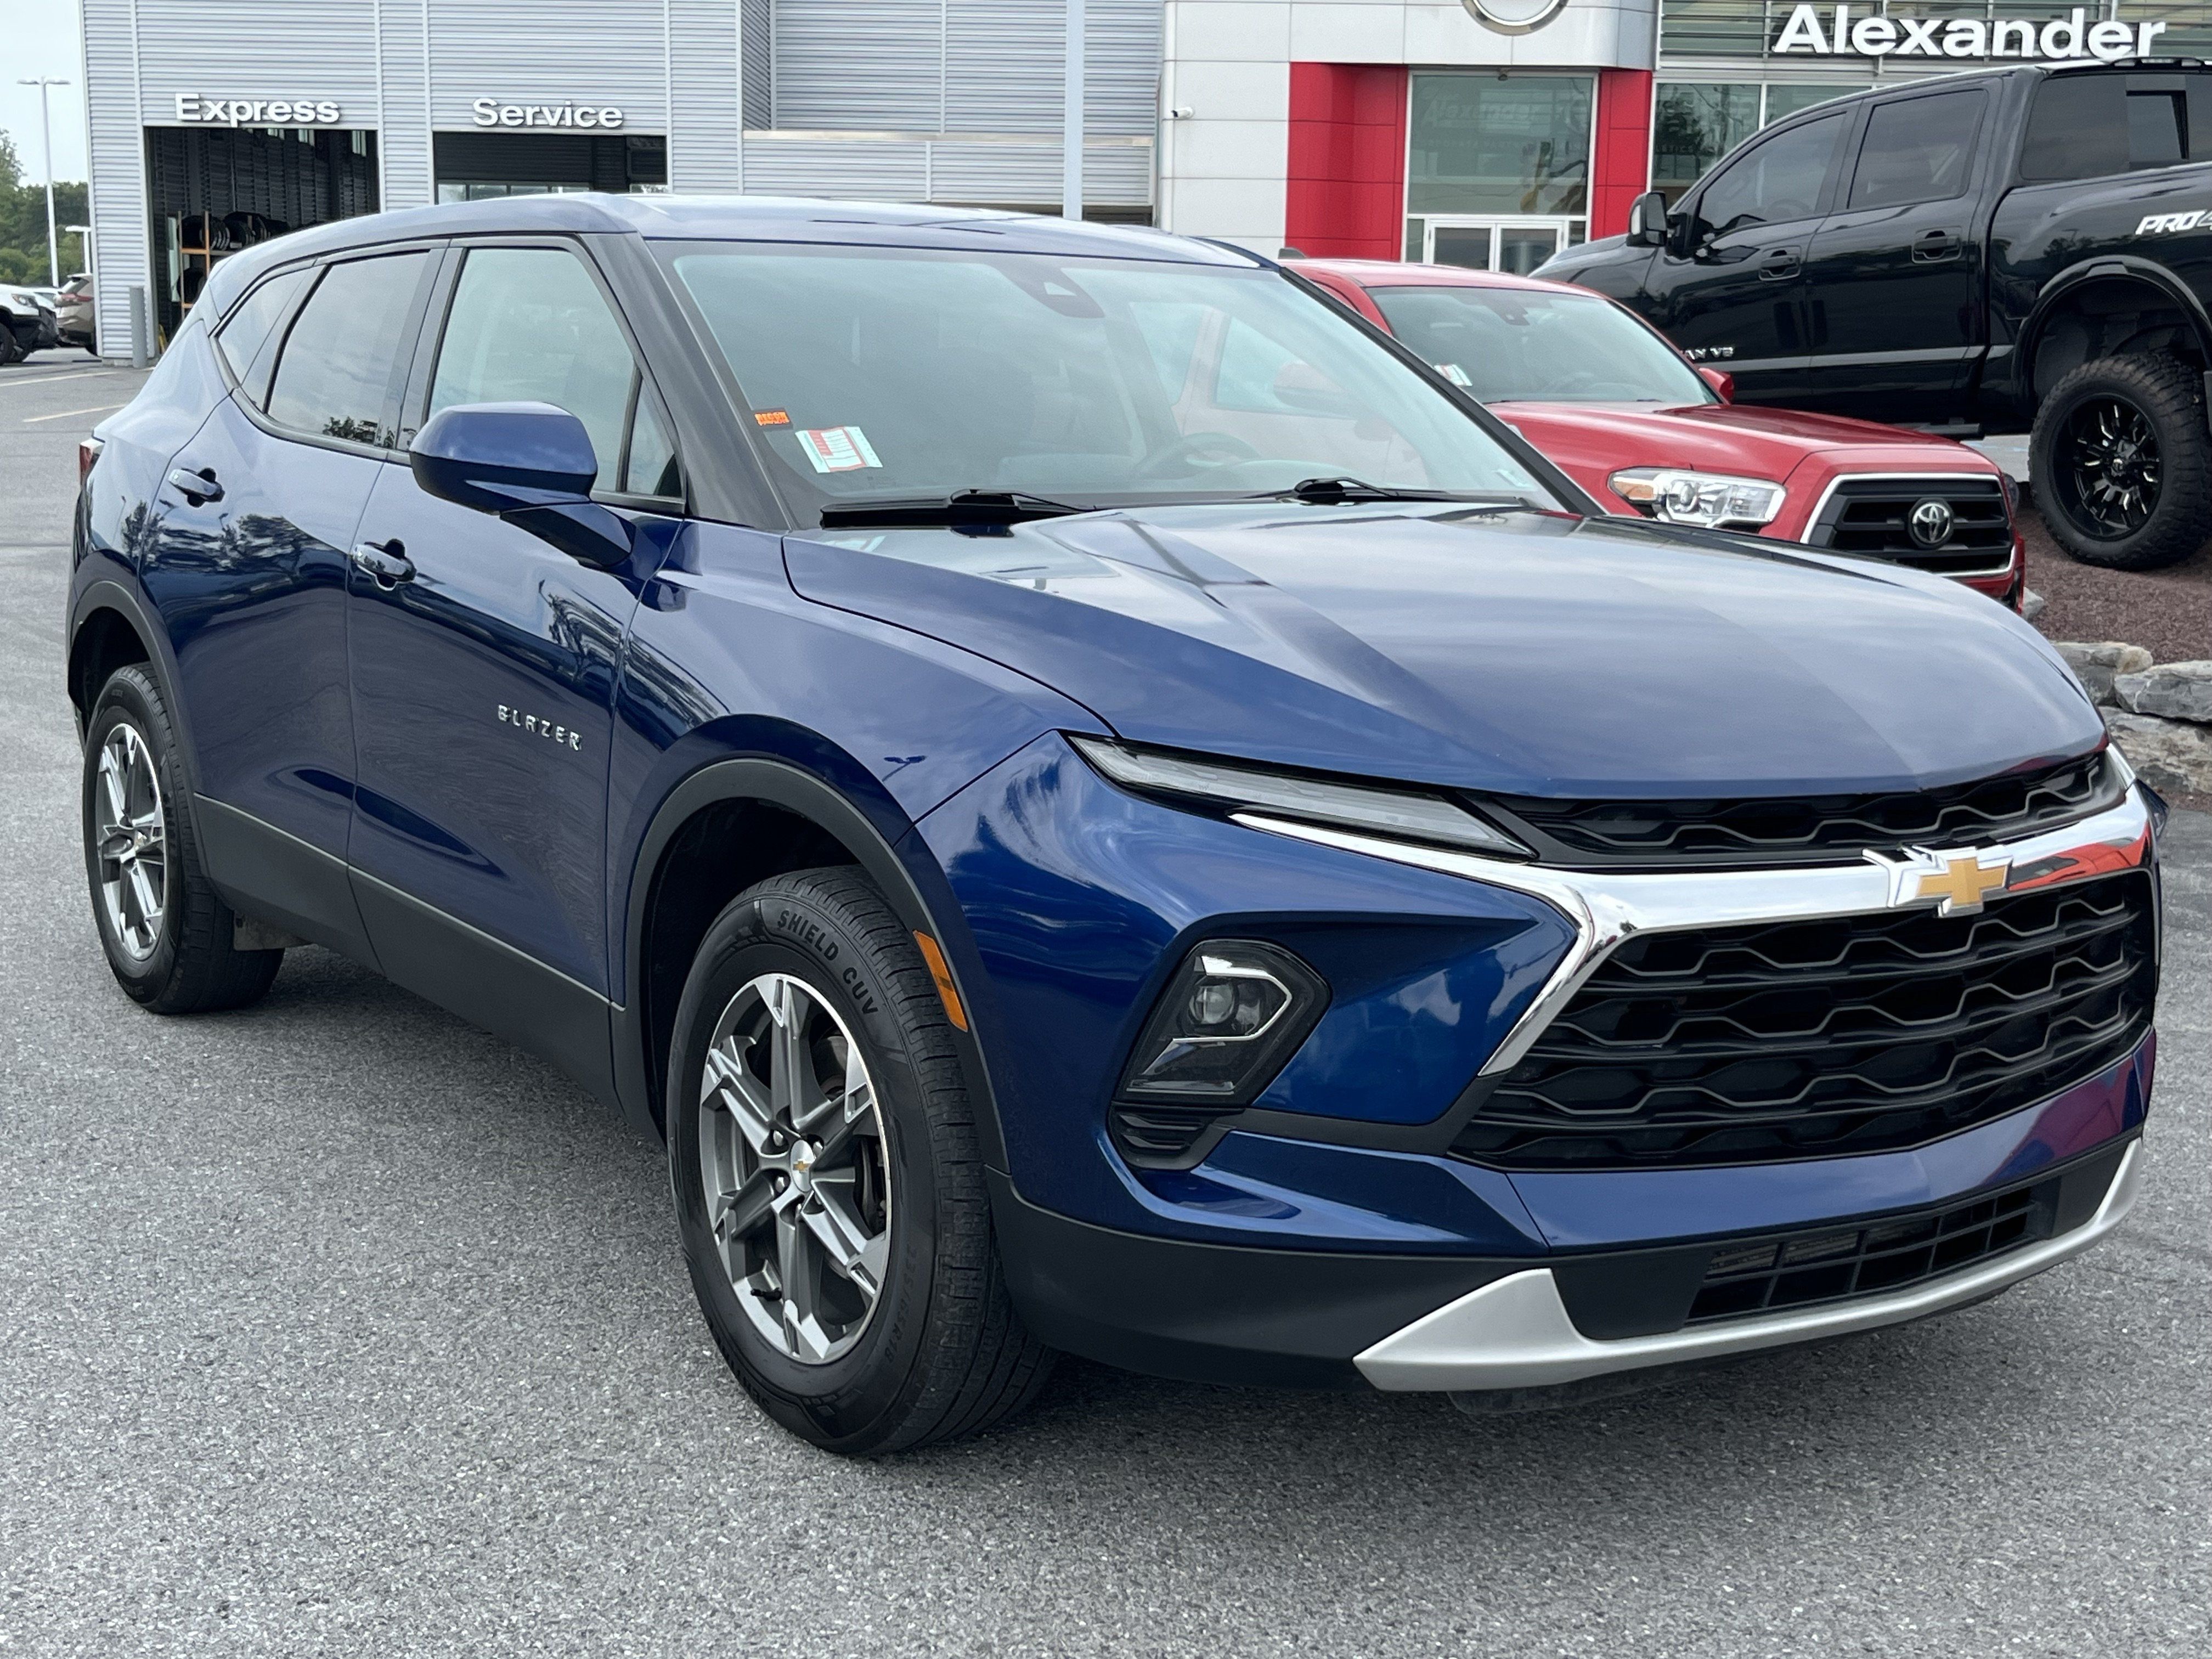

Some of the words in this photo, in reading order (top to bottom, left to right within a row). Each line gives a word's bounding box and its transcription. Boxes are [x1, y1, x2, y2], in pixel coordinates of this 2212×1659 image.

[1772, 4, 2166, 58] Alexander
[175, 93, 340, 127] Express
[473, 98, 623, 127] Service
[498, 704, 583, 752] BLAZER
[777, 910, 839, 961] SHIELD
[843, 967, 878, 1014] CUV
